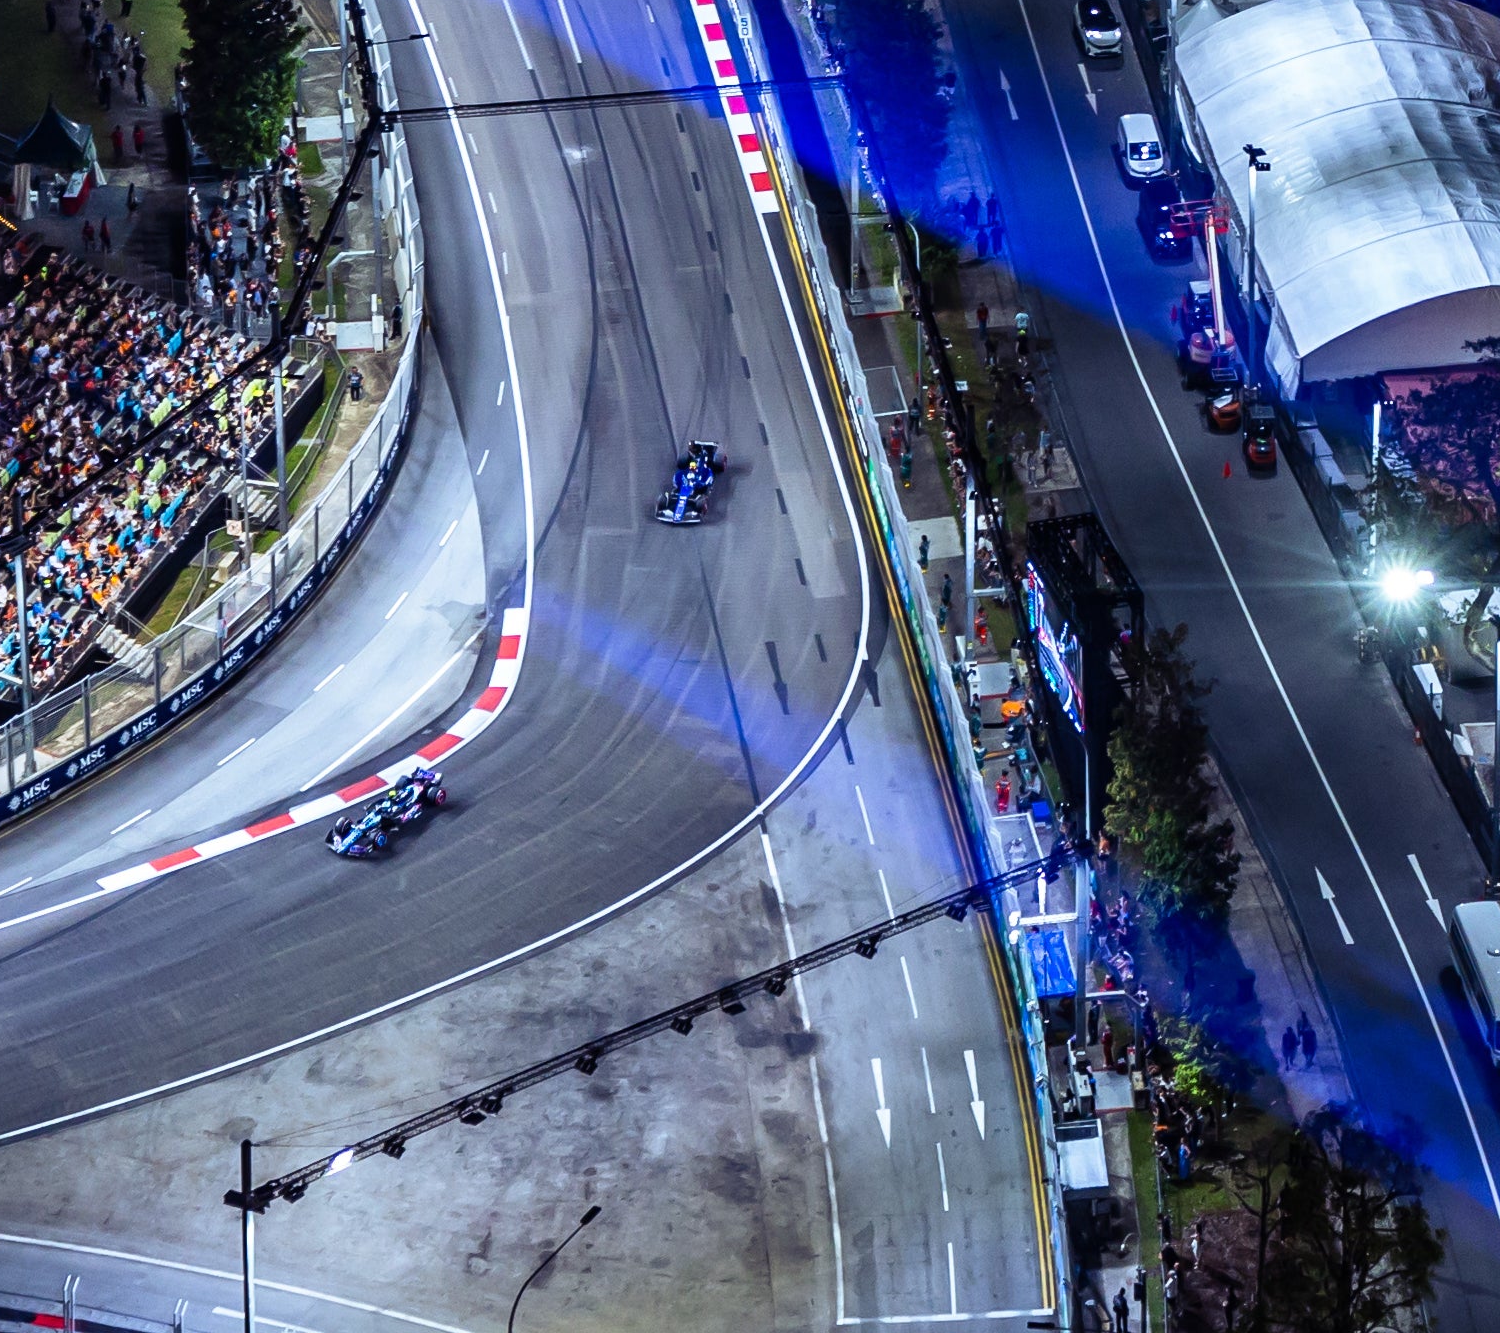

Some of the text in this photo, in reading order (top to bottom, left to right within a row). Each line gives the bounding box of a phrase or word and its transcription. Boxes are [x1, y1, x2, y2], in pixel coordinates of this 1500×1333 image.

[740, 17, 748, 36] 50
[223, 646, 244, 669] MSC
[180, 680, 204, 703] MSC
[132, 713, 157, 736] MSC
[79, 745, 106, 769] MSC
[21, 778, 50, 802] MSC
